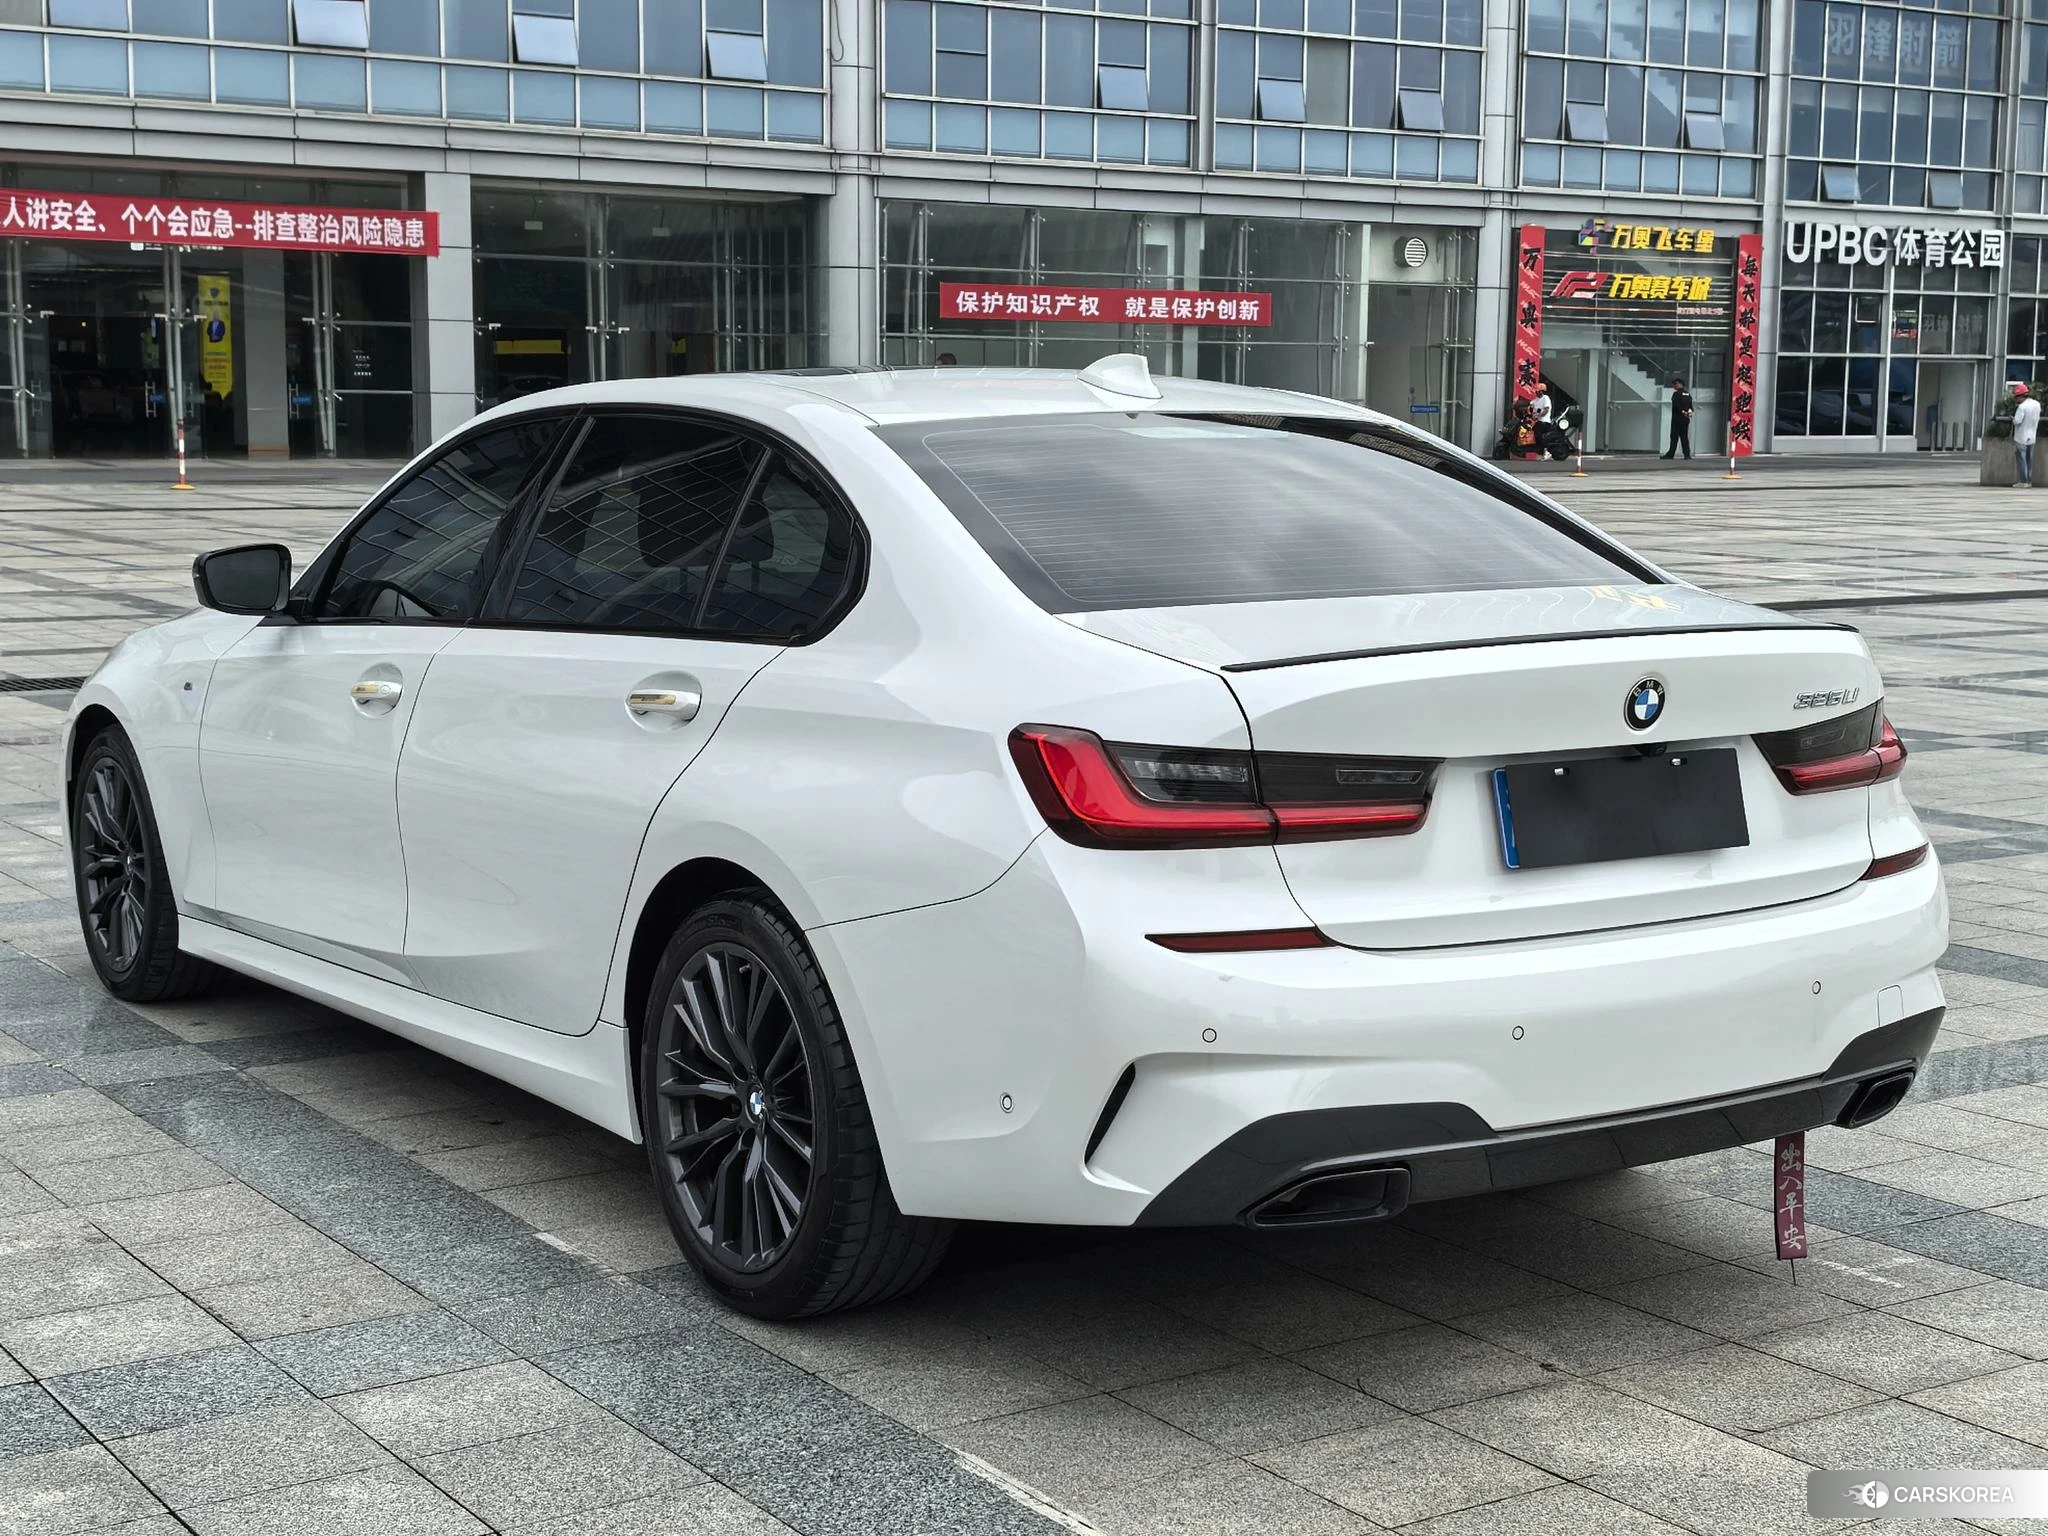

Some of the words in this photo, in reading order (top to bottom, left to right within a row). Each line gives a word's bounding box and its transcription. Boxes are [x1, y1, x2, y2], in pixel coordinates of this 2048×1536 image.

[1611, 224, 1716, 253] 万奥飞车堡
[1608, 273, 1713, 301] 万奥赛车城
[956, 290, 1100, 316] 保护知识产权
[1125, 296, 1260, 321] 就是保护创新
[1779, 1142, 1805, 1250] 出入平安
